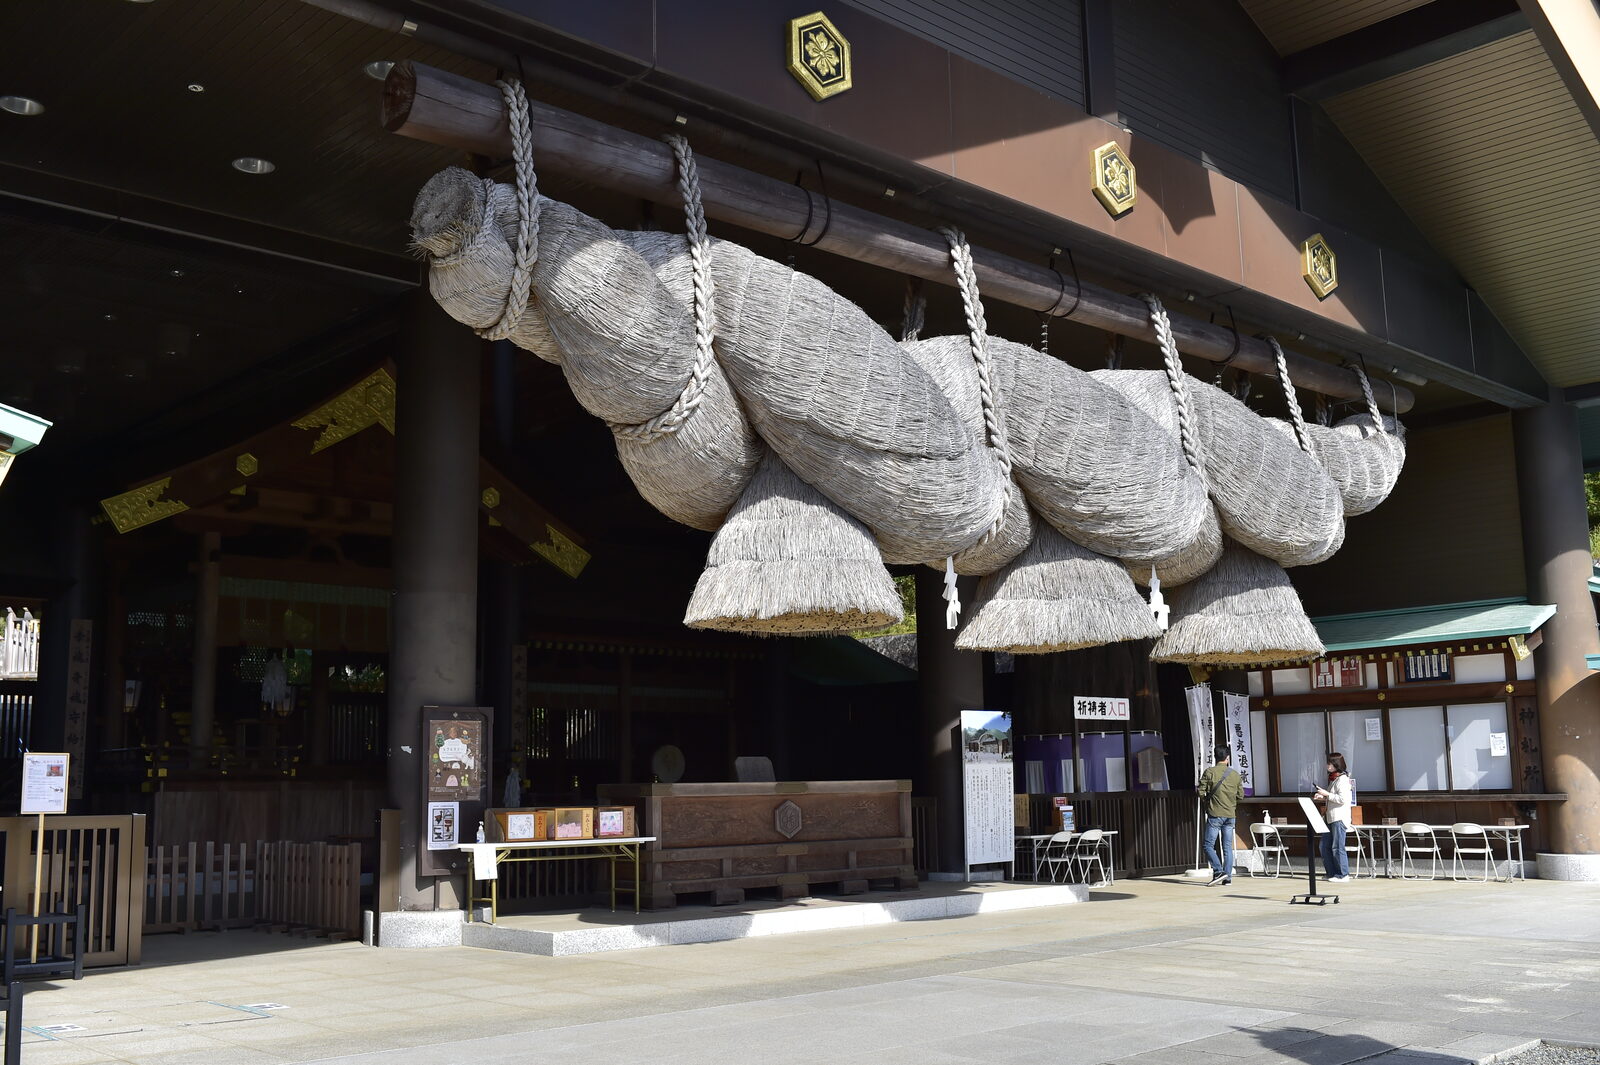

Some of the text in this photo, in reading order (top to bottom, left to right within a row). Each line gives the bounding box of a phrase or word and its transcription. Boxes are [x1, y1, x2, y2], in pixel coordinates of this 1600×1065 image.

[1077, 699, 1127, 717] 祈祷者入口
[1519, 707, 1539, 783] 神札所
